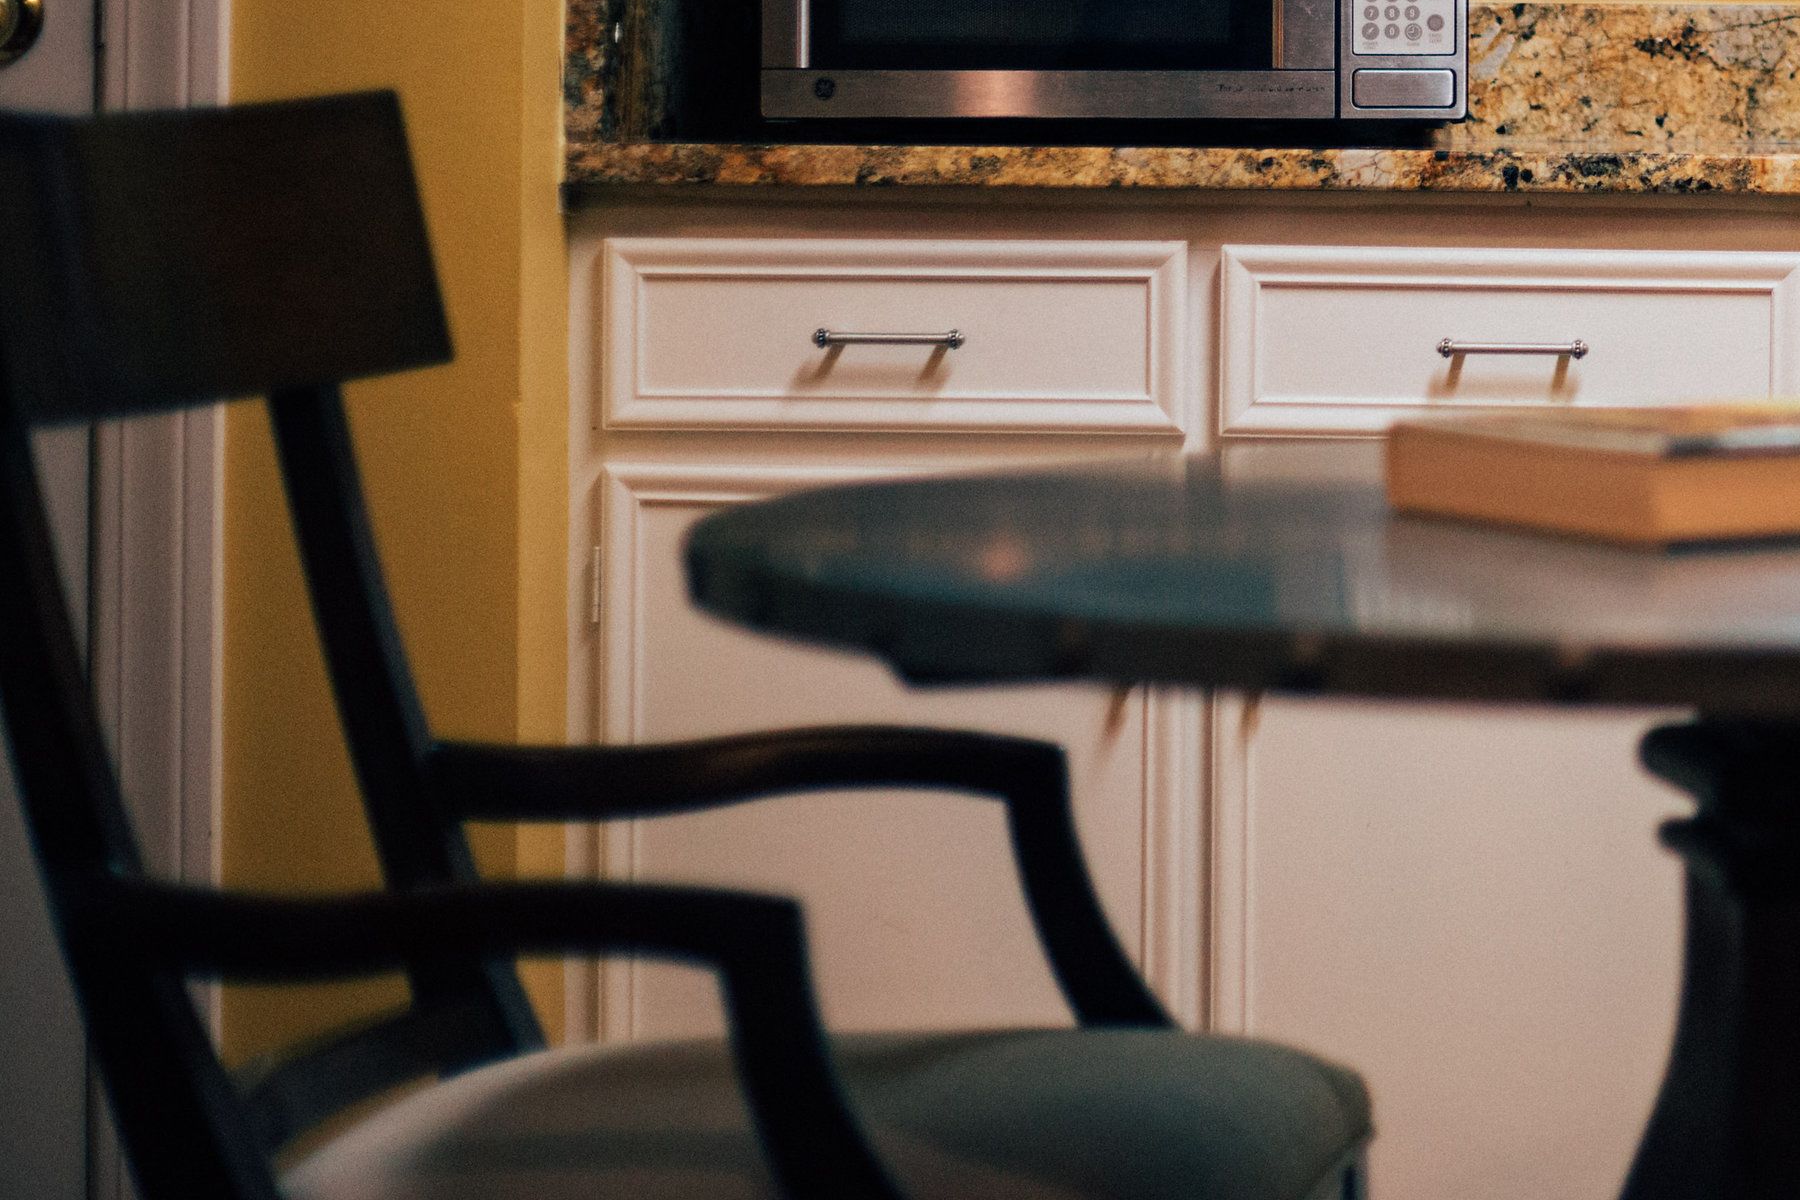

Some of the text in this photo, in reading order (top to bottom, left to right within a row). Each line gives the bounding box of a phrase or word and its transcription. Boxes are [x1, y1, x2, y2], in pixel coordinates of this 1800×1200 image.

[1369, 9, 1415, 18] 7 8 9
